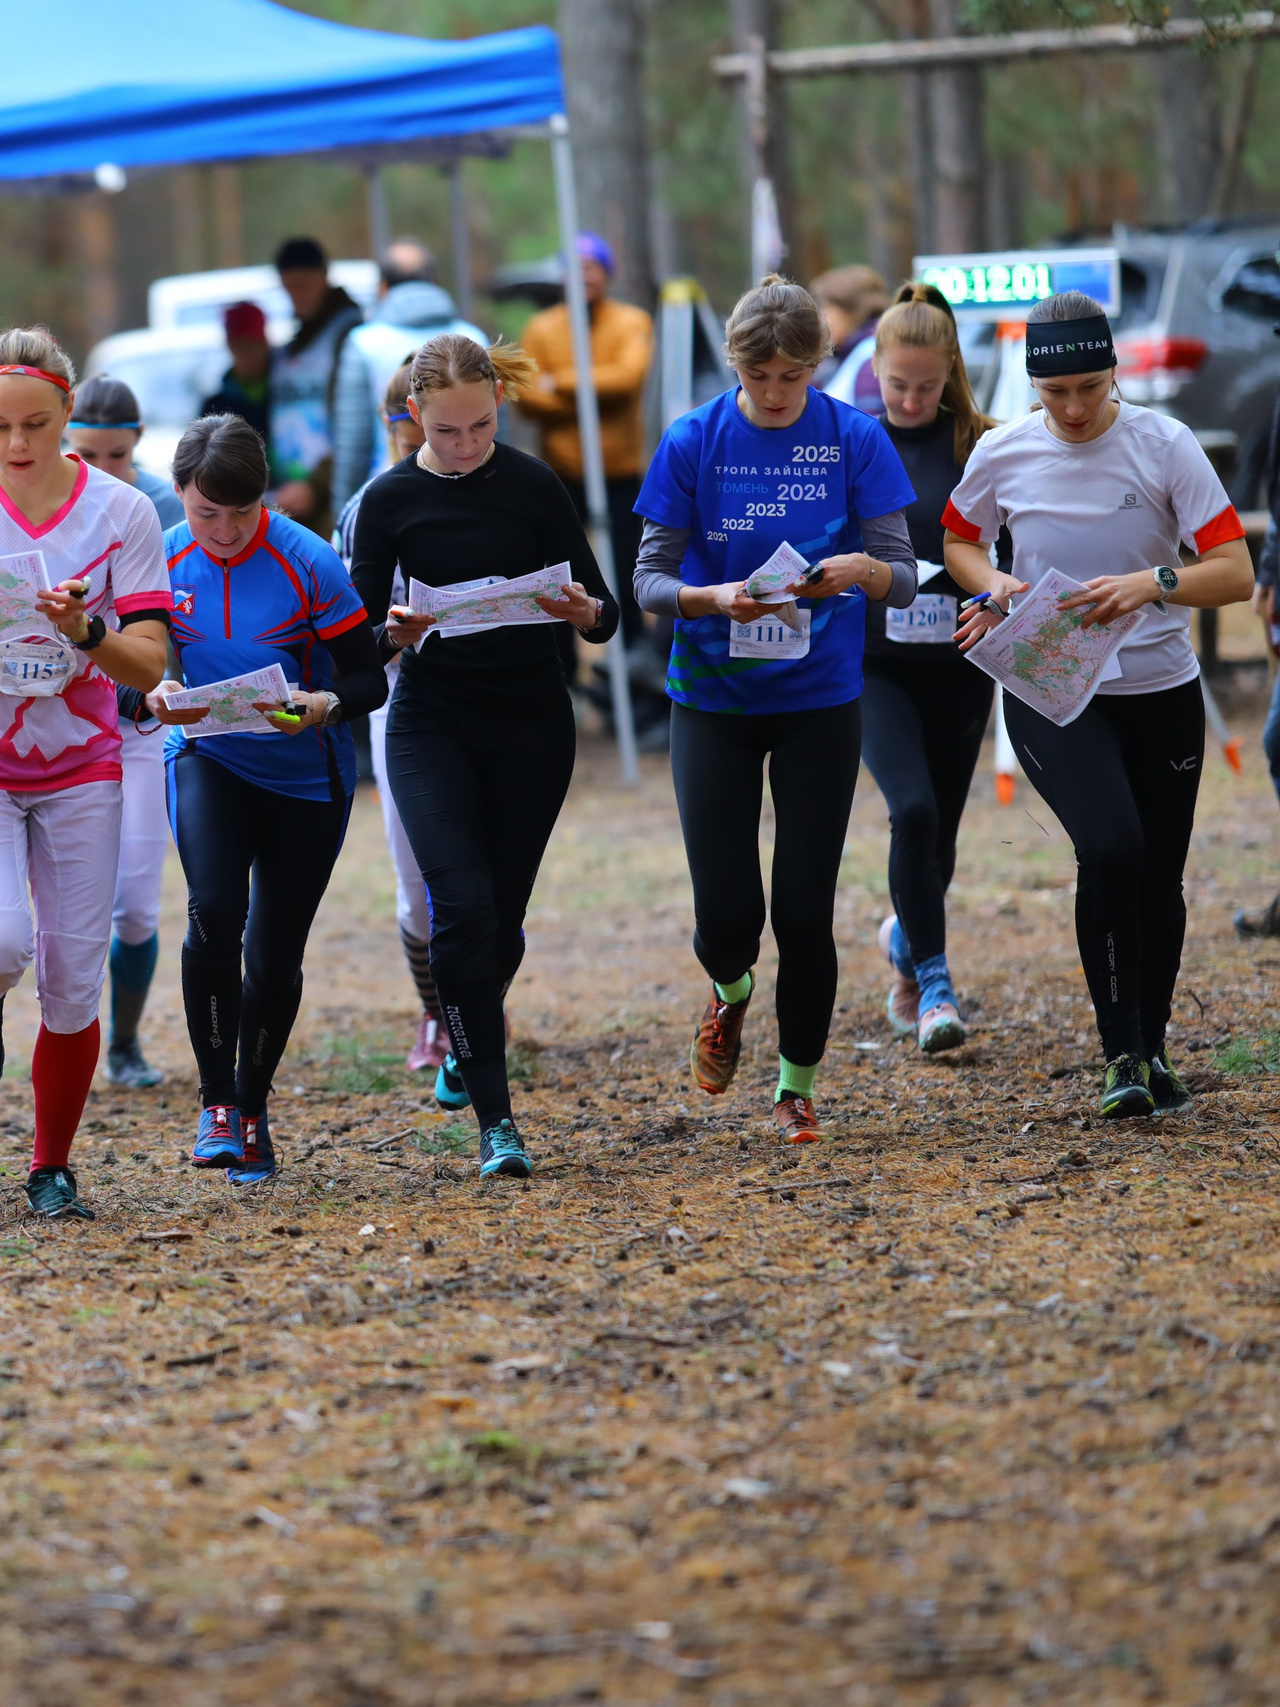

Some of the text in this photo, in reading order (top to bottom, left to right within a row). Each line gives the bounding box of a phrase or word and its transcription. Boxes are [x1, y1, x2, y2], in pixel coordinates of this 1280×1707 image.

[1032, 340, 1109, 356] ORIENTEAM
[791, 445, 841, 463] 2025
[715, 465, 828, 477] ТРОПА ЗАЙЦЕВА
[776, 483, 828, 501] 2024
[745, 503, 787, 517] 2023
[722, 518, 755, 531] 2022
[707, 531, 729, 542] 2021
[908, 610, 938, 626] 120
[756, 625, 784, 643] 111
[22, 662, 53, 680] 115
[1106, 931, 1116, 972] VICTORY
[210, 995, 219, 1034] NORD
[446, 1005, 473, 1059] noname
